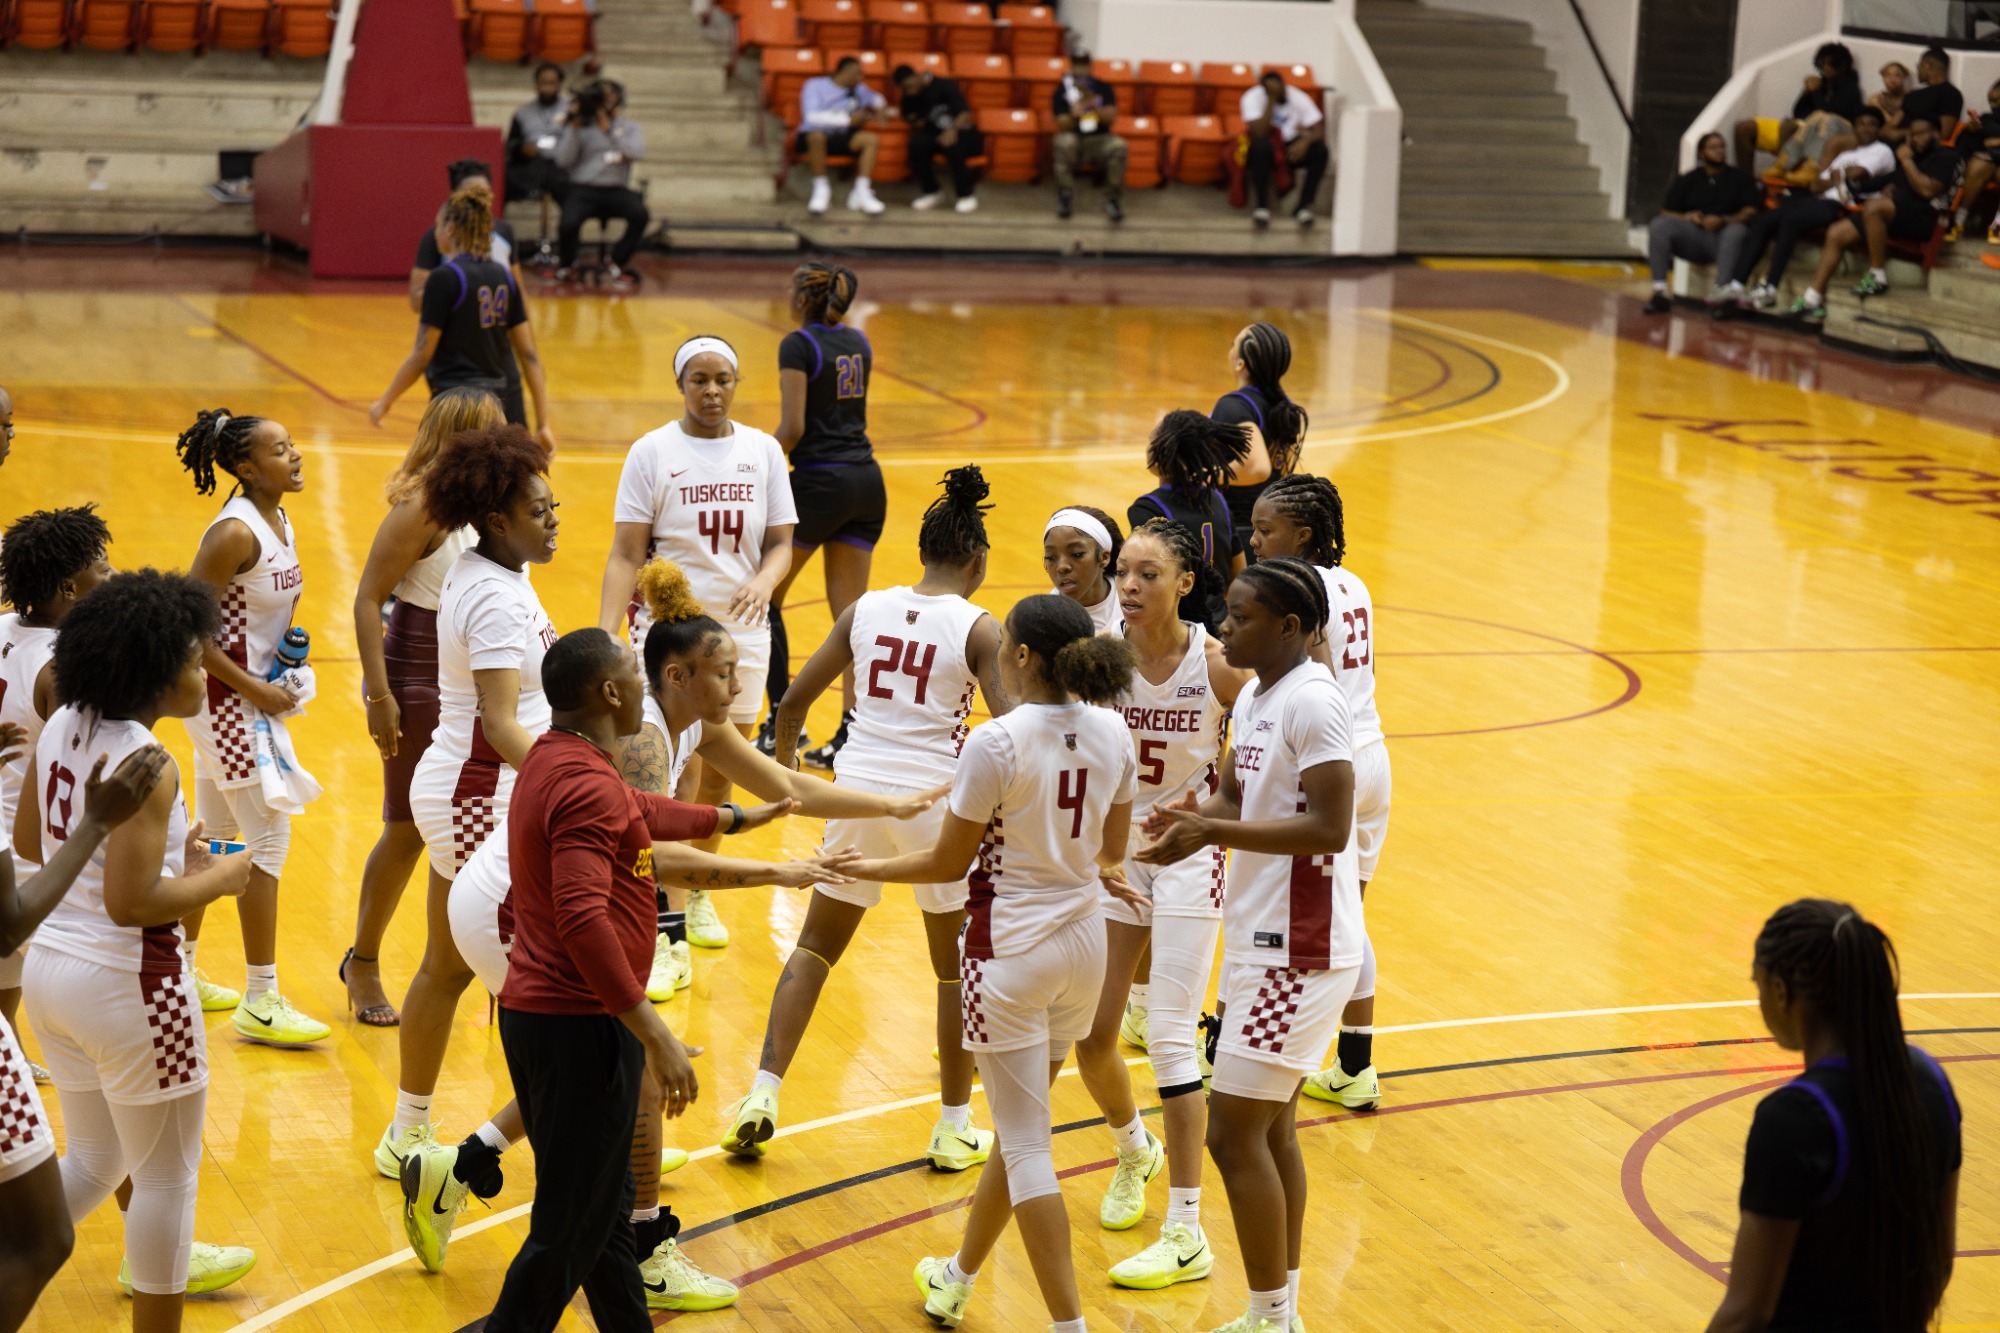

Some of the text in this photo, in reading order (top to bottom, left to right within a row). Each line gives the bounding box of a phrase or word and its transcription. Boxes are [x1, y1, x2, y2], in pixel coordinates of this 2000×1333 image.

[478, 284, 509, 328] 24
[836, 353, 865, 400] 21
[679, 483, 754, 505] TUSKEGEE
[698, 509, 744, 555] 44
[1342, 607, 1369, 670] 23
[867, 634, 937, 706] 24
[1138, 739, 1167, 785] 5
[1058, 768, 1088, 838] 4
